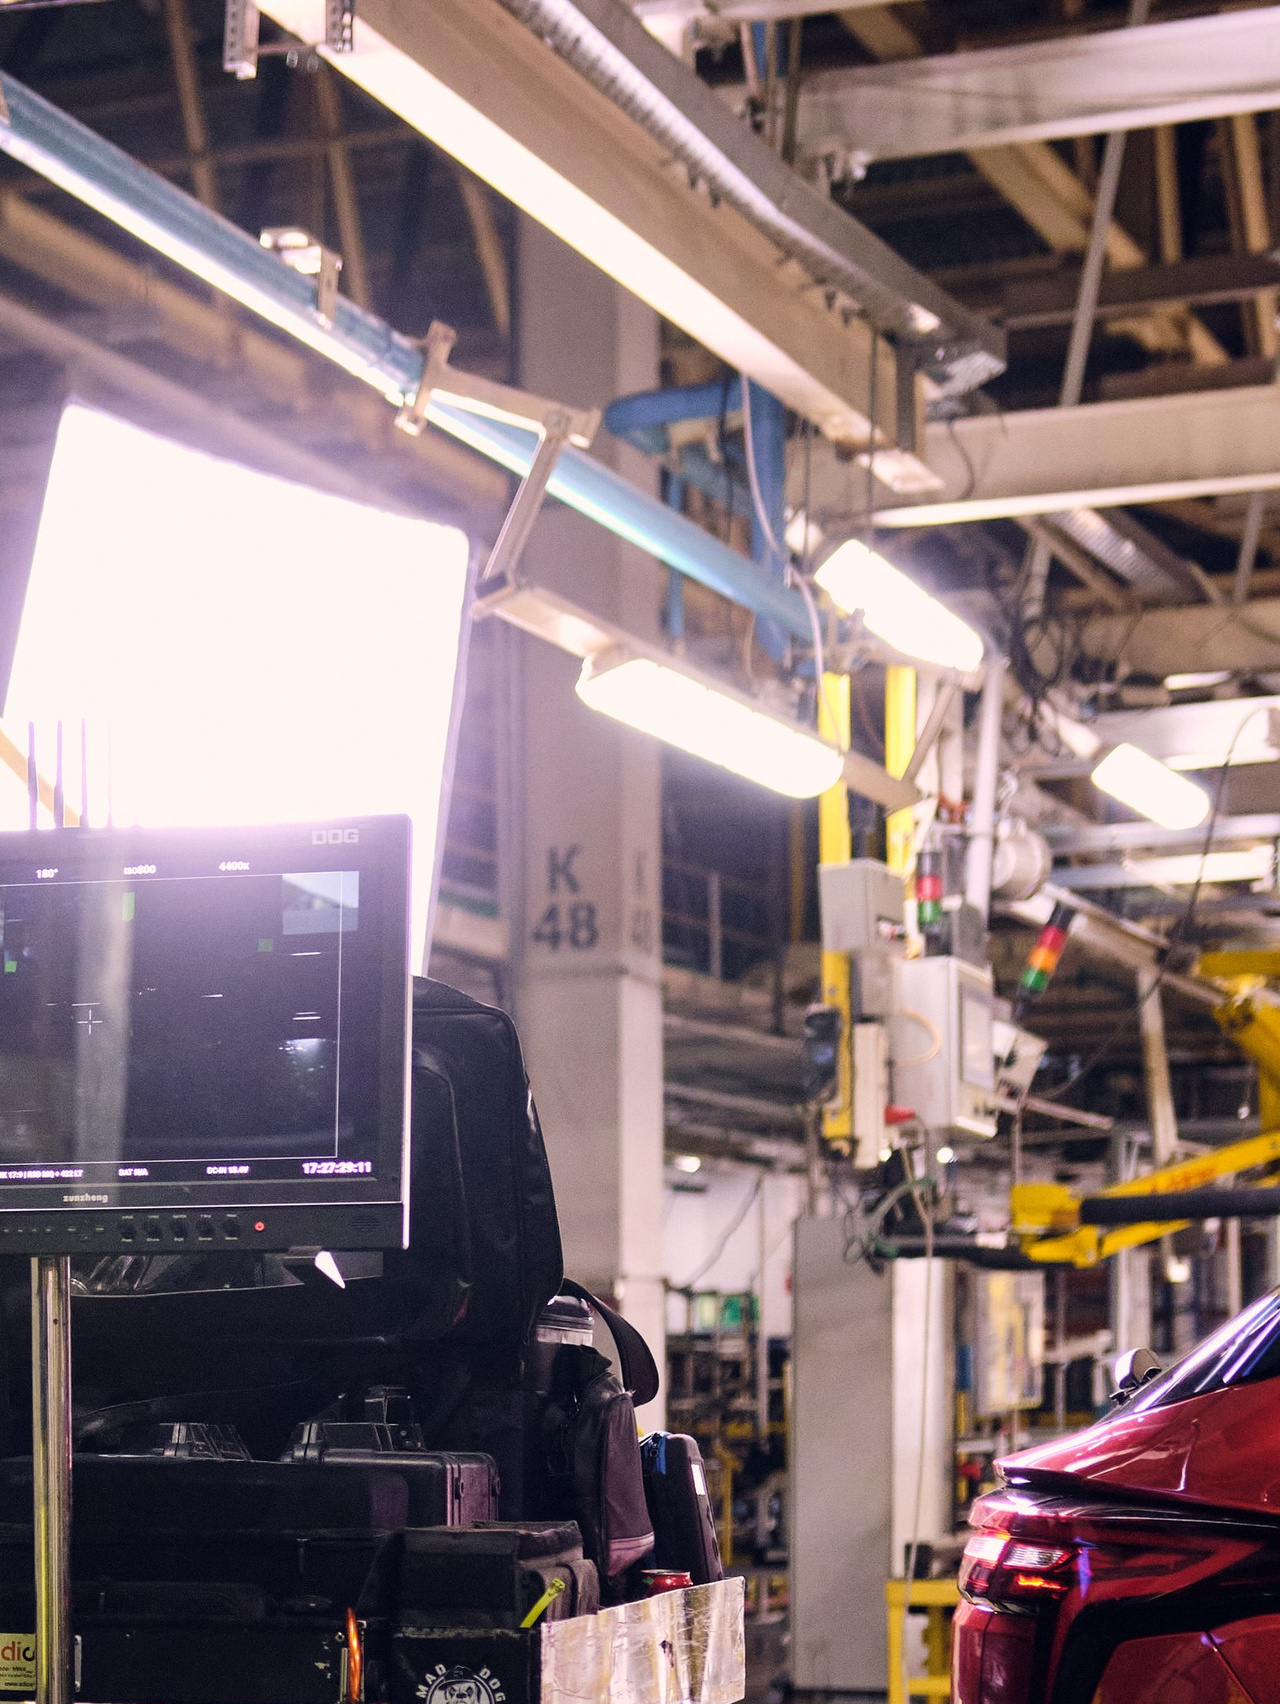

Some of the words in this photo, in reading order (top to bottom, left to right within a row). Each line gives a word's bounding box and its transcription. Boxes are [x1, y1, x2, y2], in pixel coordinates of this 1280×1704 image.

[36, 868, 59, 879] 180°
[532, 904, 599, 952] 48
[62, 1192, 109, 1204] zunzheng
[415, 1663, 448, 1699] MAD
[479, 1667, 506, 1702] DOG
